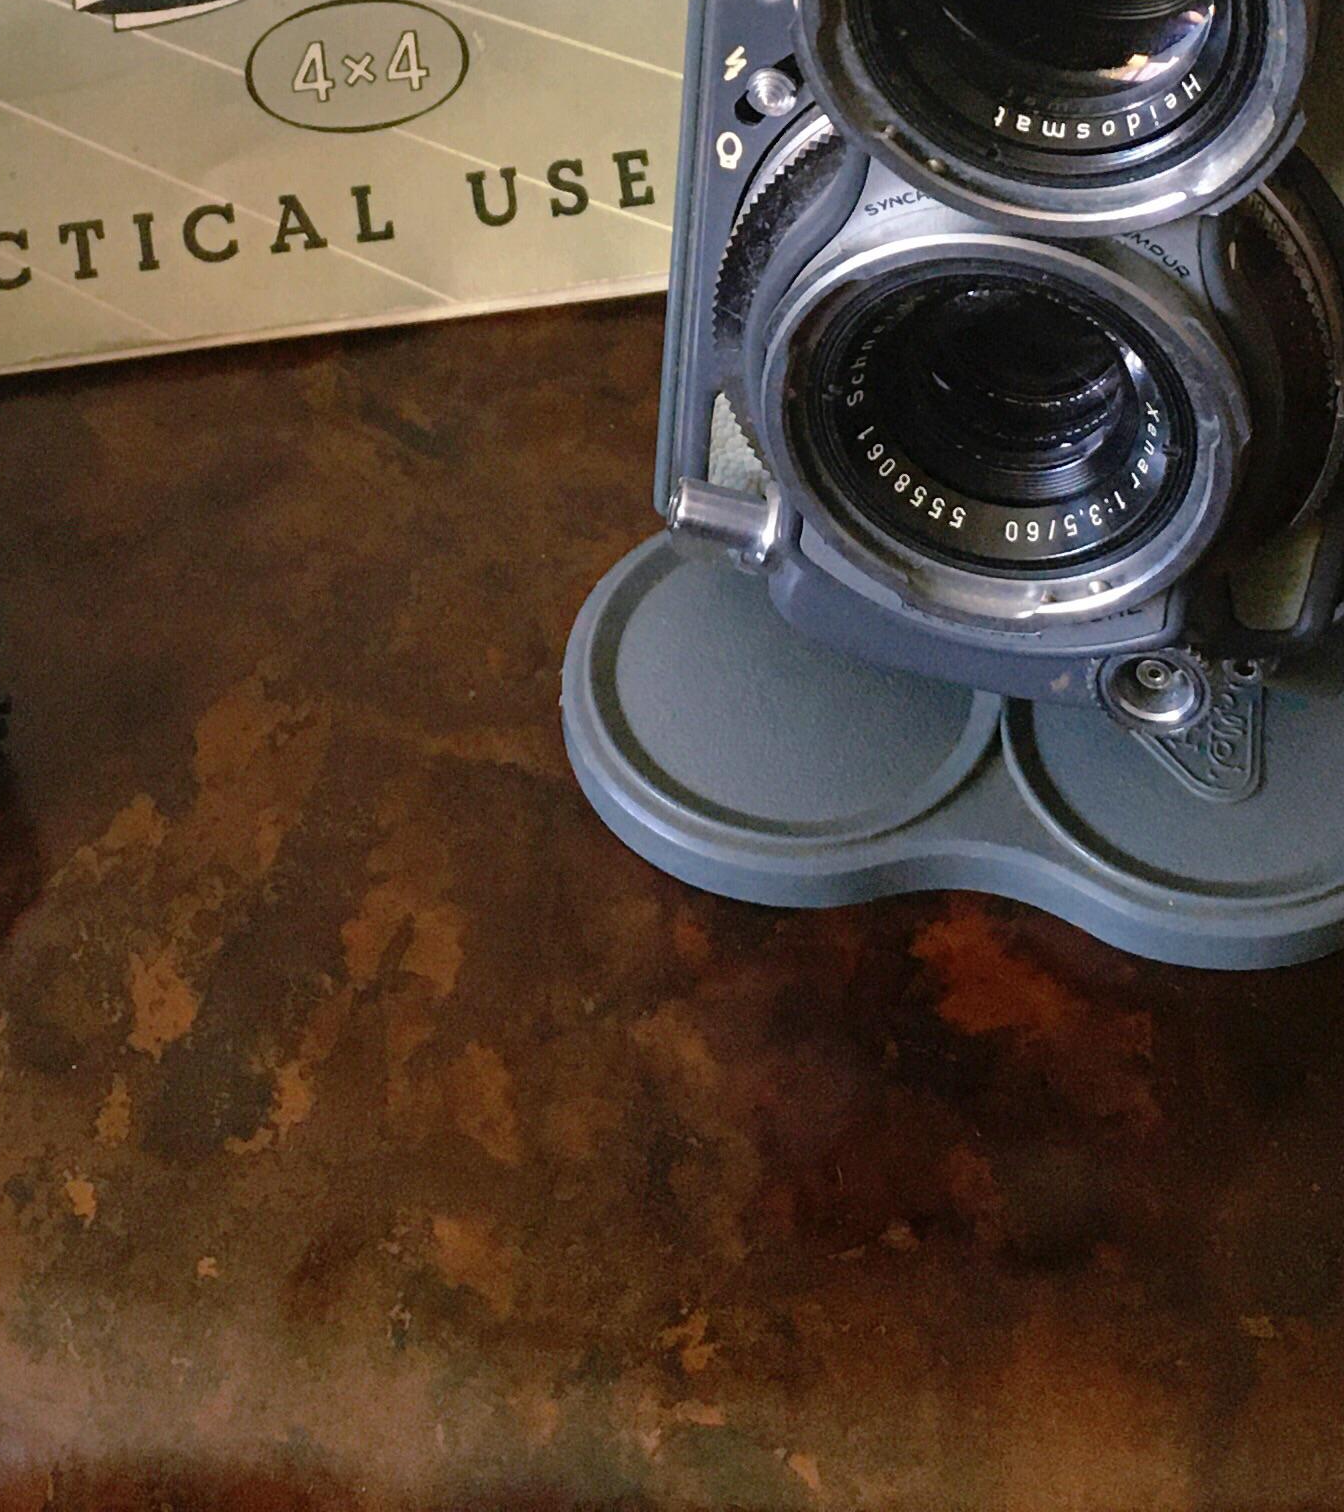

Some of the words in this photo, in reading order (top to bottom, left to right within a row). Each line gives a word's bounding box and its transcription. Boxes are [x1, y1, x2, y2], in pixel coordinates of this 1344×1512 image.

[993, 73, 1202, 141] Heidosmat
[465, 149, 656, 227] USE
[857, 426, 967, 529] 5558061
[1128, 400, 1161, 490] Xenar
